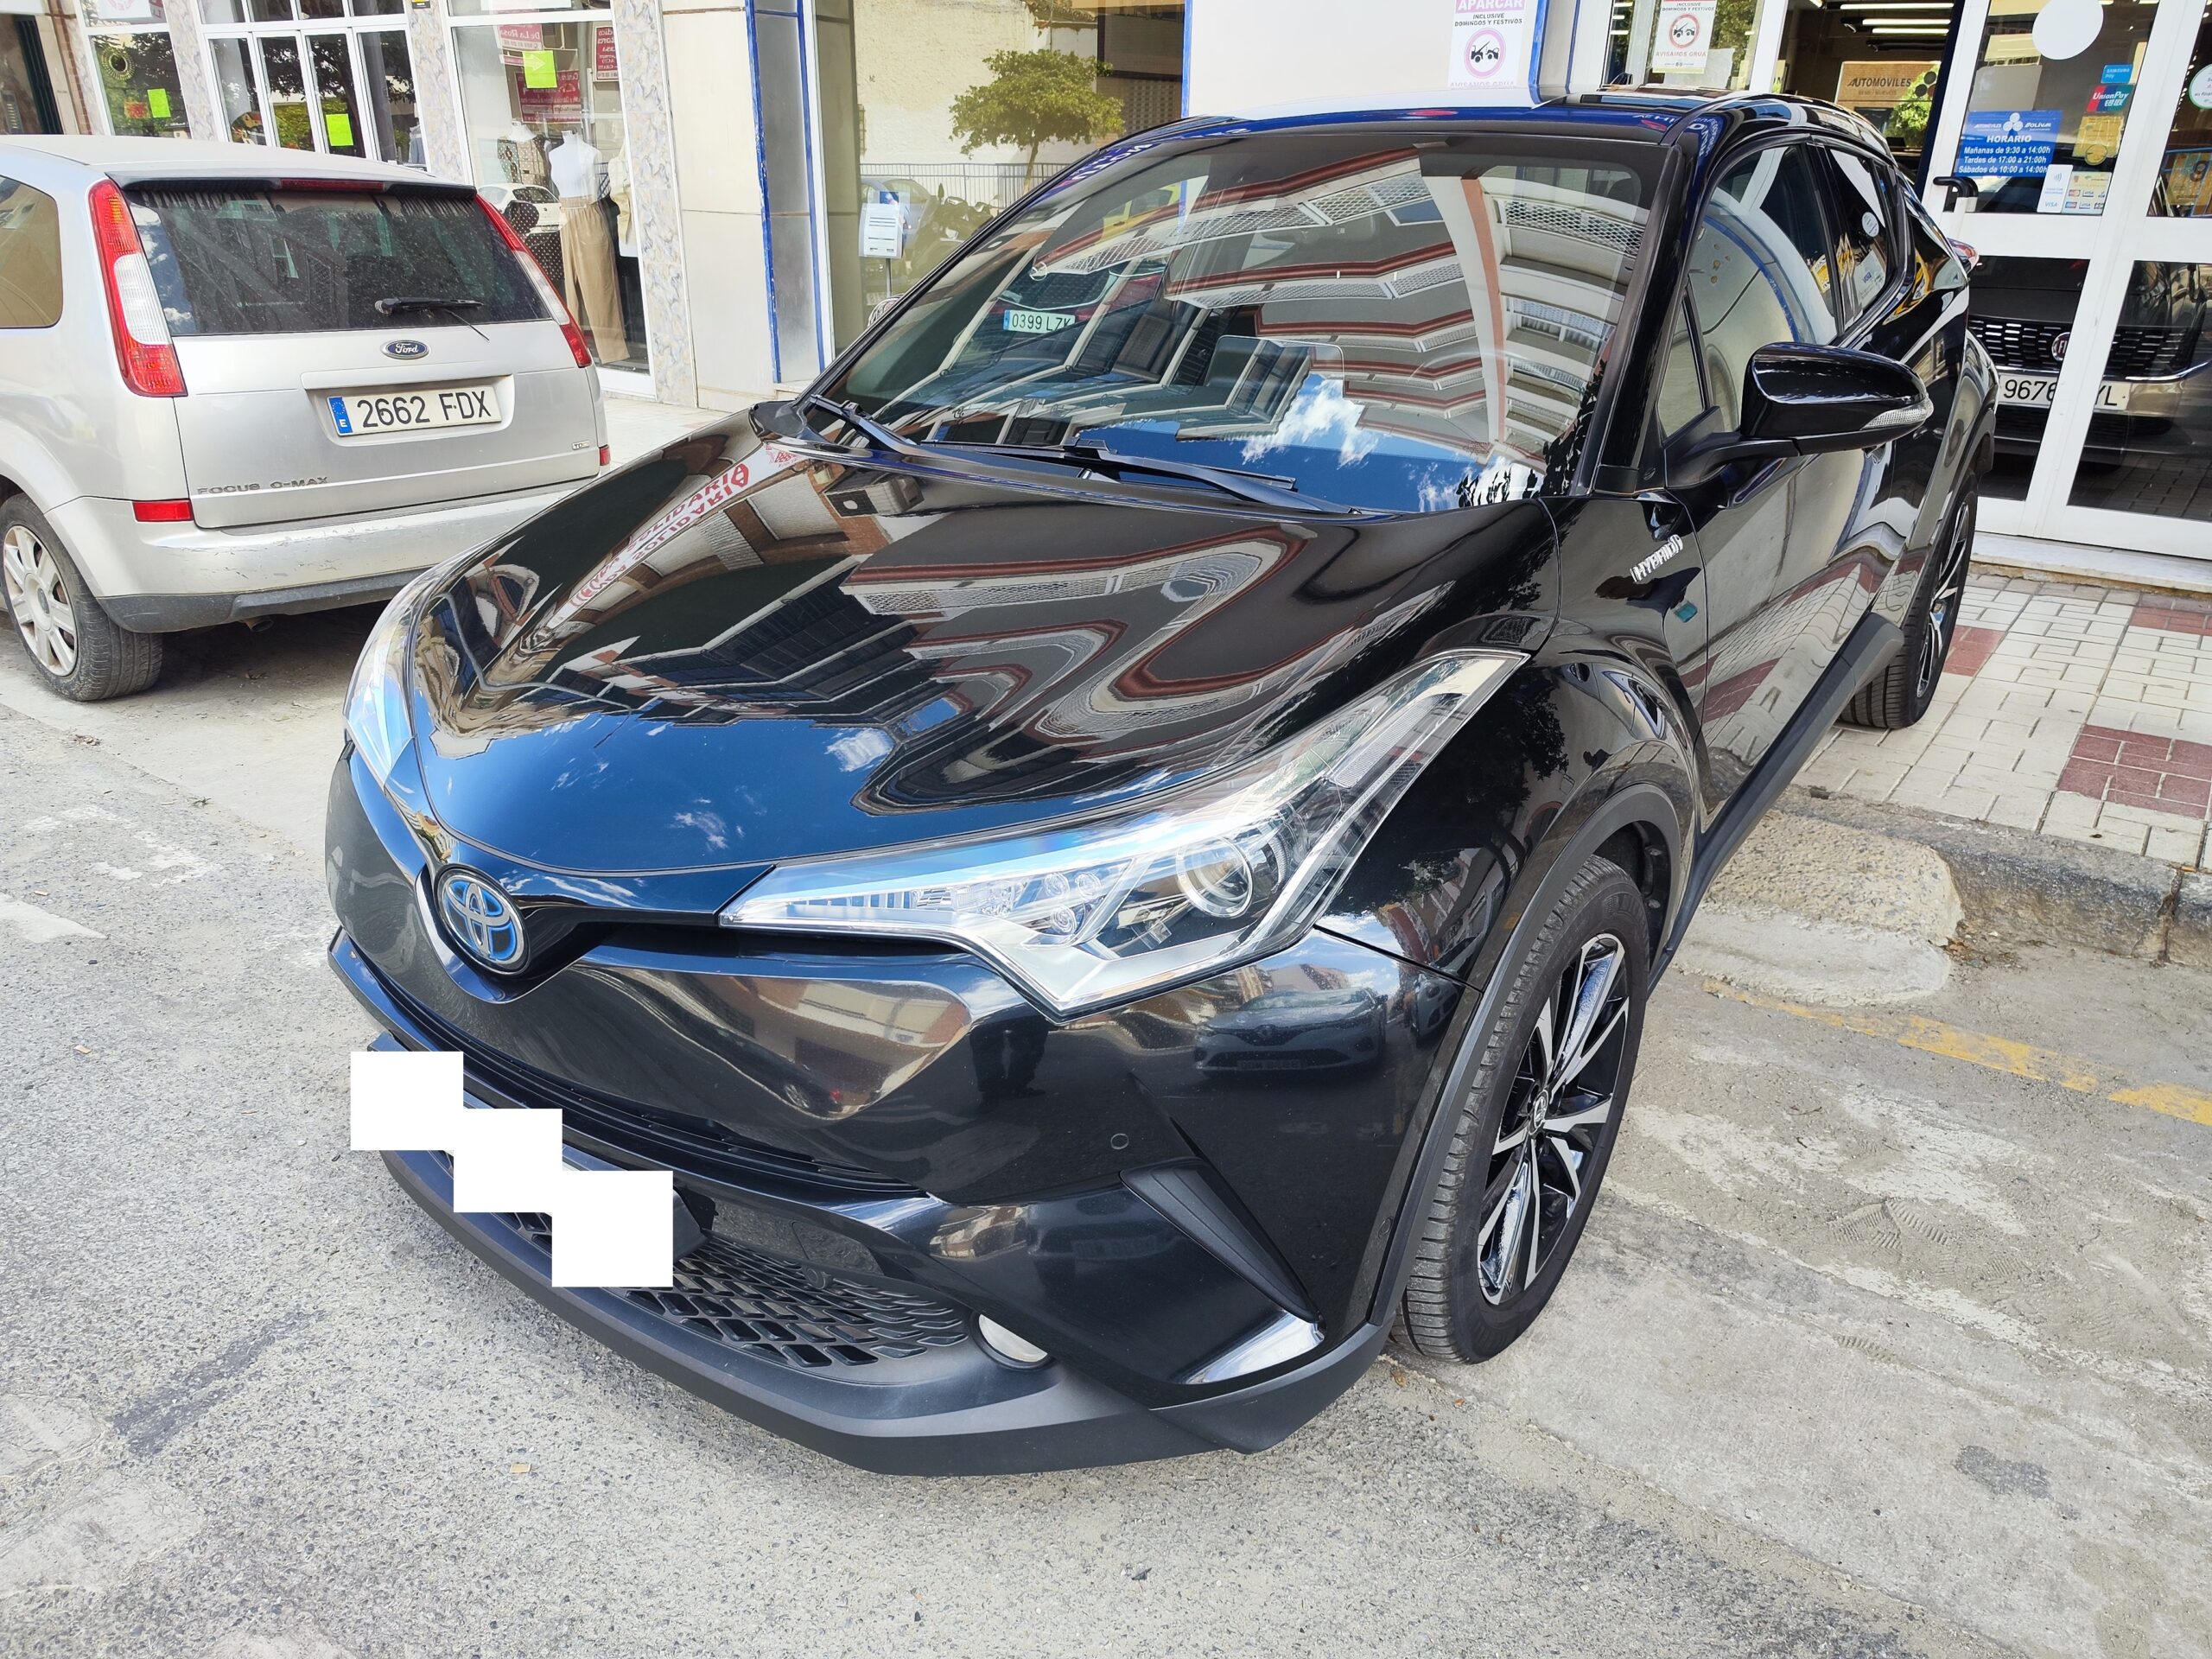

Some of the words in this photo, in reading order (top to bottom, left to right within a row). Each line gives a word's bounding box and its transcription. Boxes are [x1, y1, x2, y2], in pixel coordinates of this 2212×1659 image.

[1458, 0, 1522, 11] APARCAR
[1847, 78, 1911, 87] AUTOMOVILES
[2093, 91, 2129, 101] UnionPay
[1986, 135, 2032, 143] HORARIO
[1012, 314, 1043, 330] 0399
[395, 343, 419, 354] Ford
[2003, 378, 2057, 402] 9676
[339, 419, 347, 428] E
[357, 396, 430, 428] 2662
[438, 391, 491, 421] FDX
[196, 483, 260, 495] FOCUS
[270, 476, 328, 489] C-MAX
[1630, 534, 1683, 582] HYBRID
